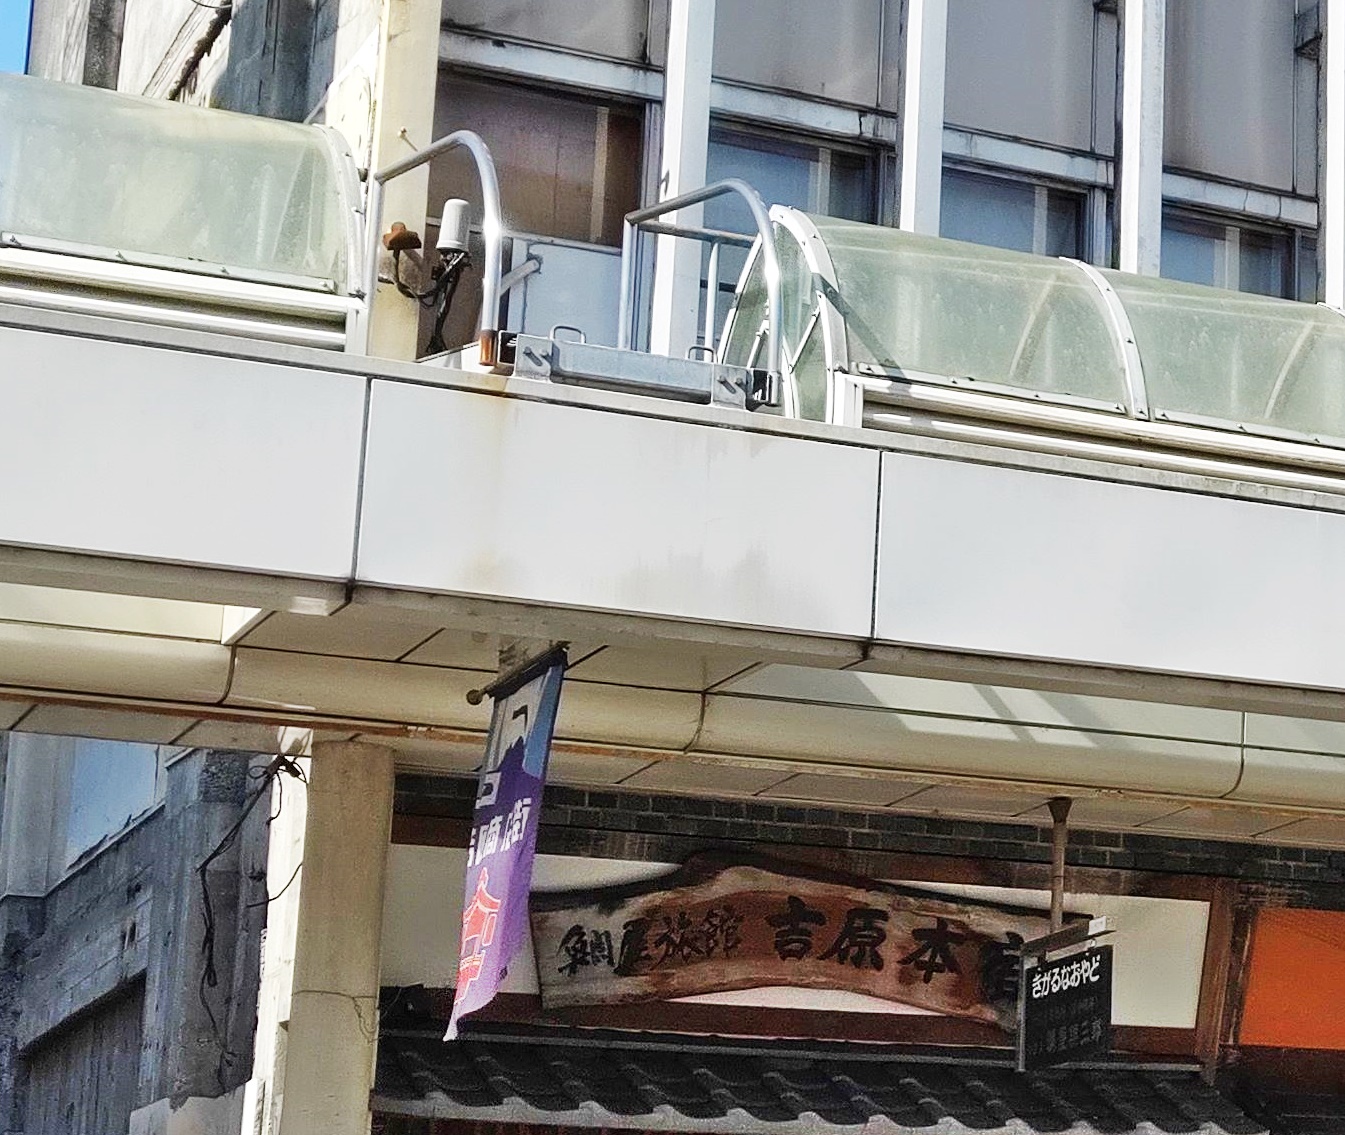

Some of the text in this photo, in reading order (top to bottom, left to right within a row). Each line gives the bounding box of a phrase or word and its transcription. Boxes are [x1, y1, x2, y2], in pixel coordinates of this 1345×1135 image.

[561, 906, 742, 977] 鯛屋旅館
[1032, 955, 1100, 998] きがるなおやど
